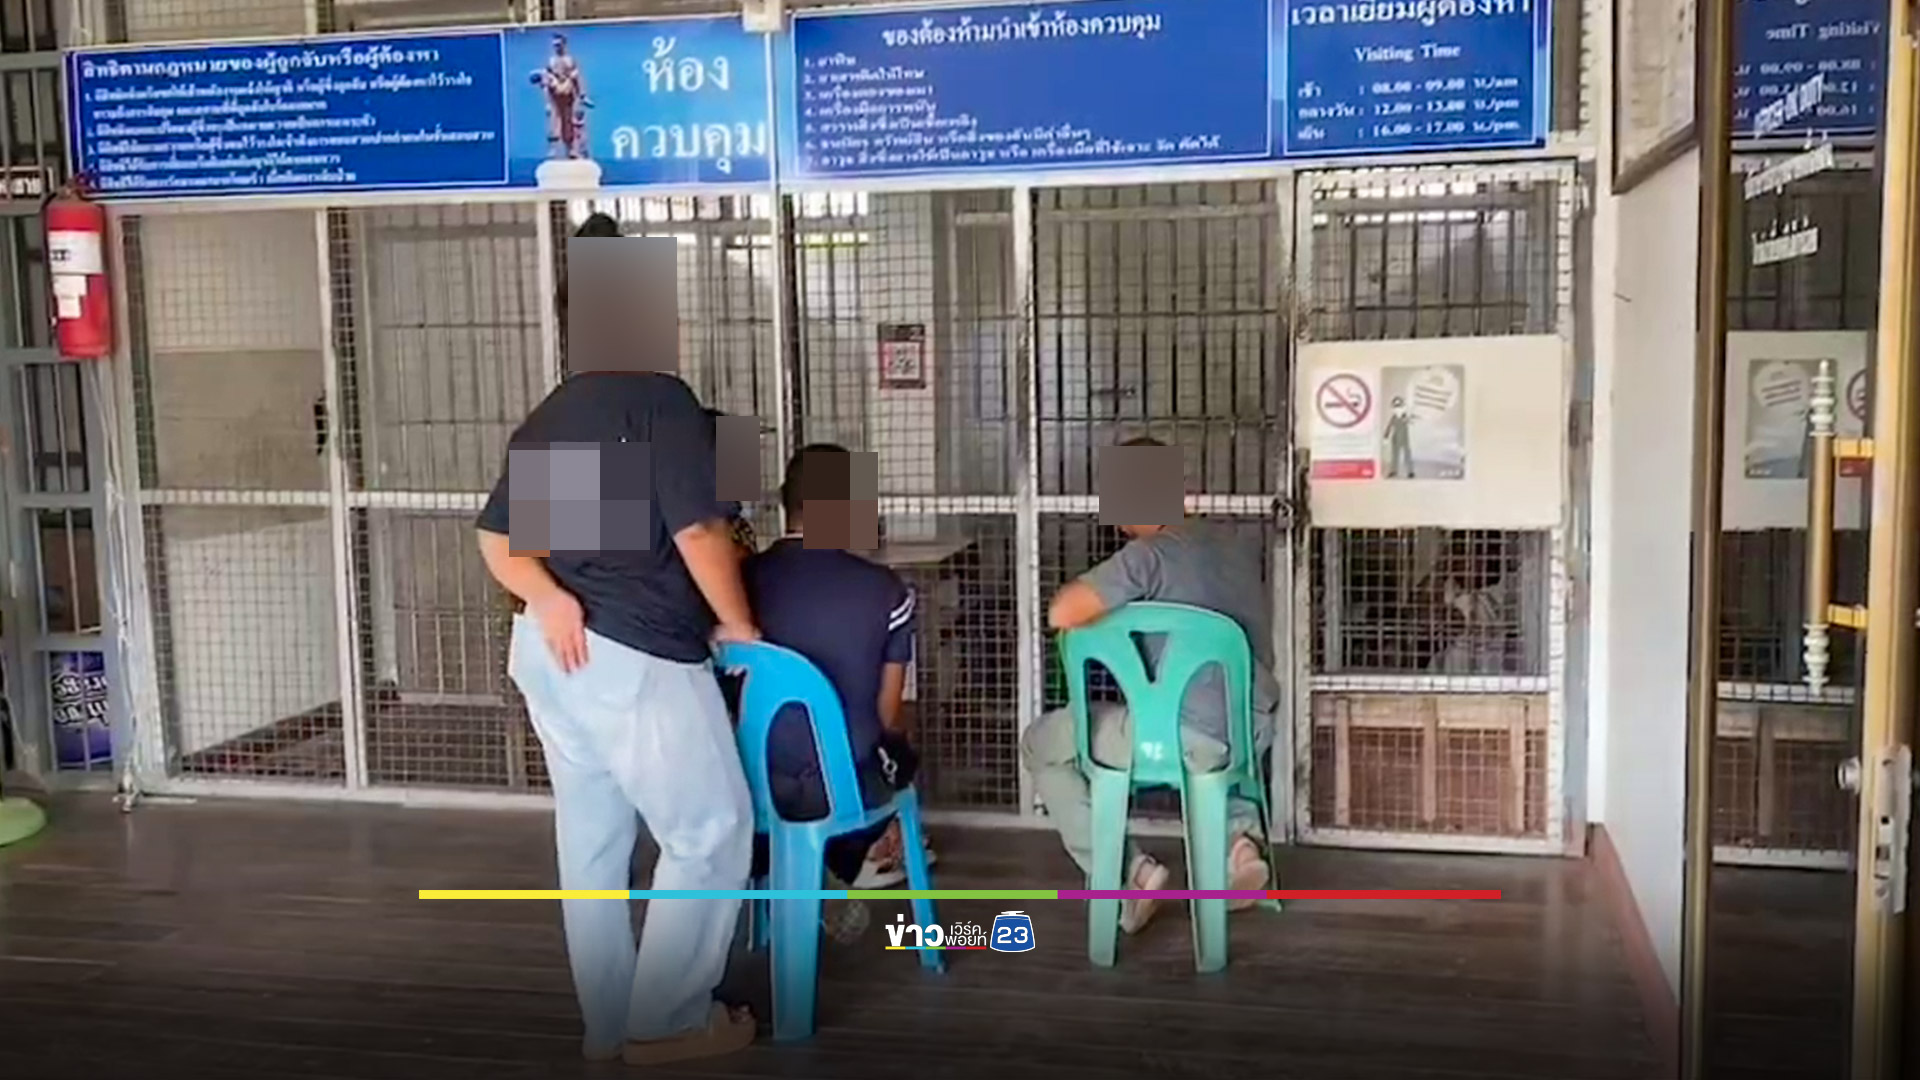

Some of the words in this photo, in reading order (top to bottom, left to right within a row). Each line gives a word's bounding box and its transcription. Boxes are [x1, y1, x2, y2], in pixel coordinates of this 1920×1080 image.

[882, 9, 1161, 47] ของต้องห้ามนำเข้าห้องควบคุม
[642, 36, 731, 93] ห้อง
[1354, 44, 1414, 63] Visiting
[1420, 43, 1461, 58] Time
[1298, 101, 1356, 119] กลางวัน
[1374, 103, 1413, 116] 12.00
[1373, 122, 1413, 138] 16.00
[1426, 120, 1466, 134] 17.00
[611, 121, 767, 175] ควบคุม
